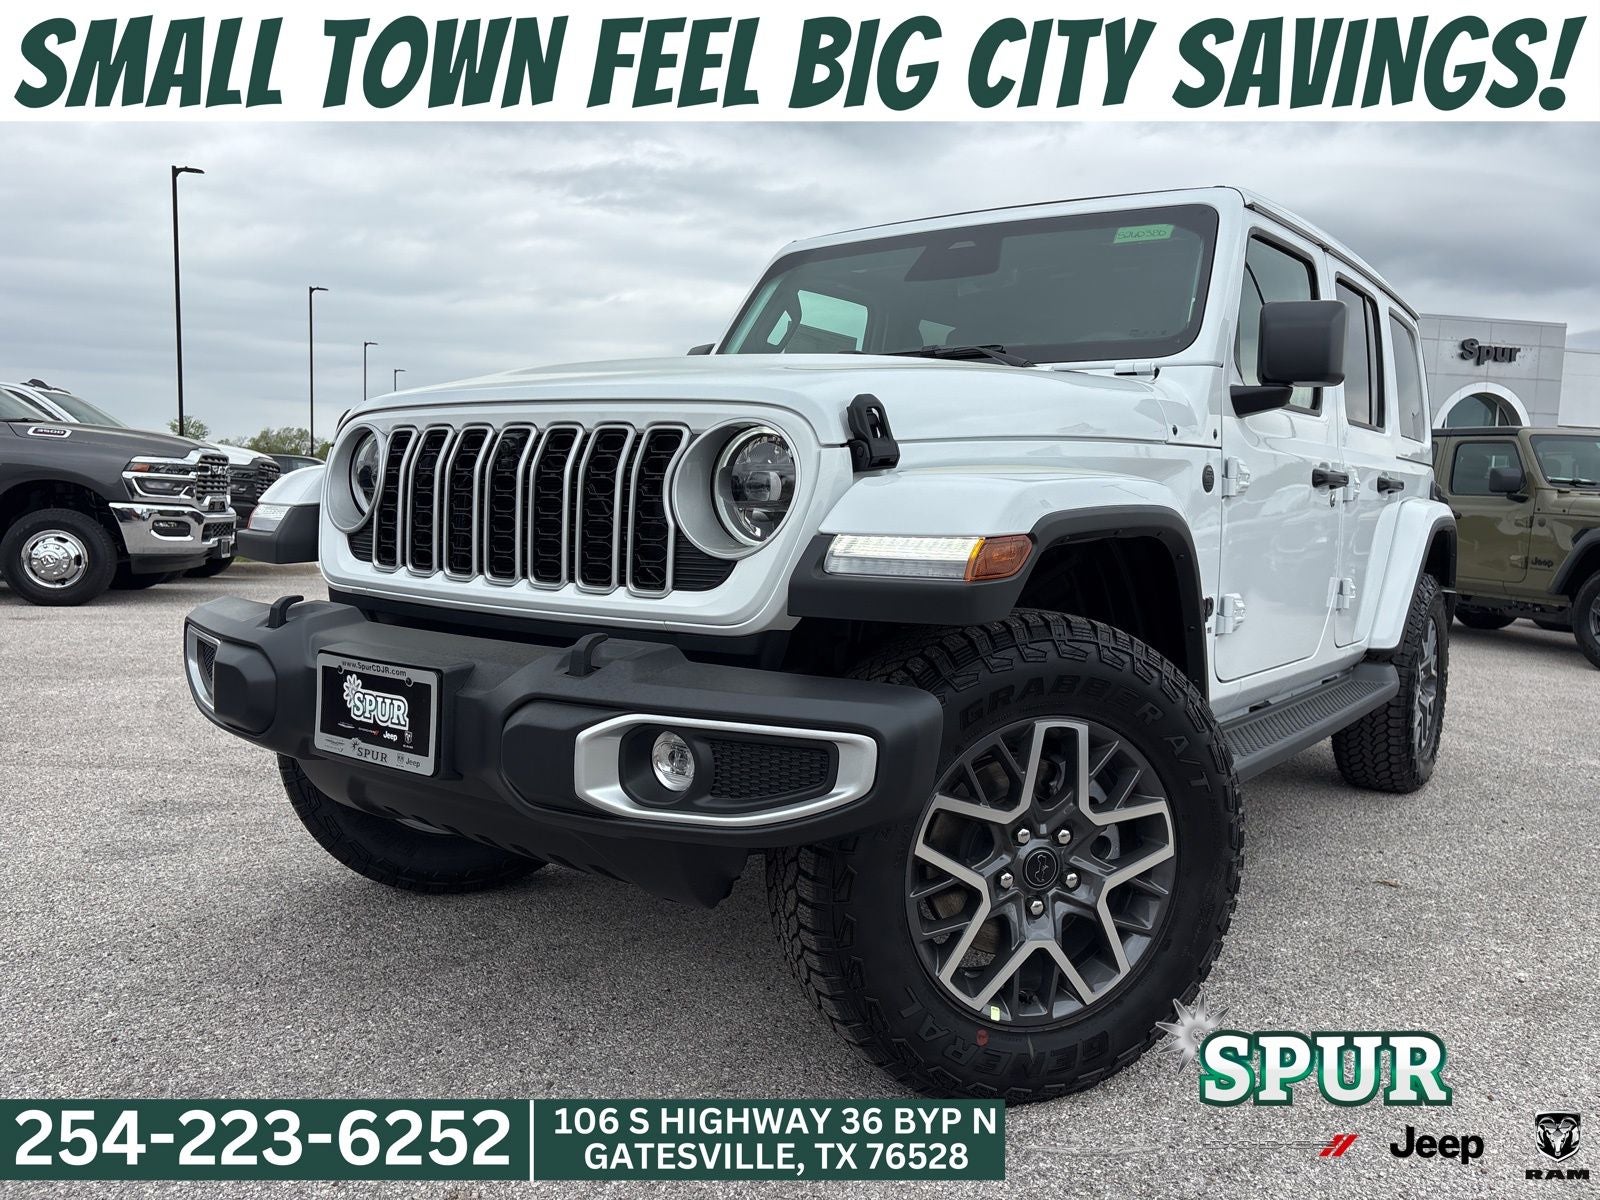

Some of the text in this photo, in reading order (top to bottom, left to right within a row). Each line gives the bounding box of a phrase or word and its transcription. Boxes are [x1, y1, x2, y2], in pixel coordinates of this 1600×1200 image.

[1461, 338, 1521, 366] Spur
[342, 661, 406, 676] www.SpurCDJR.com
[352, 691, 407, 726] SPUR
[959, 674, 1165, 730] GRABBER
[383, 731, 398, 742] Jeep
[357, 747, 388, 762] SPUR
[406, 758, 421, 768] Jeep
[900, 984, 1109, 1077] GENERAL
